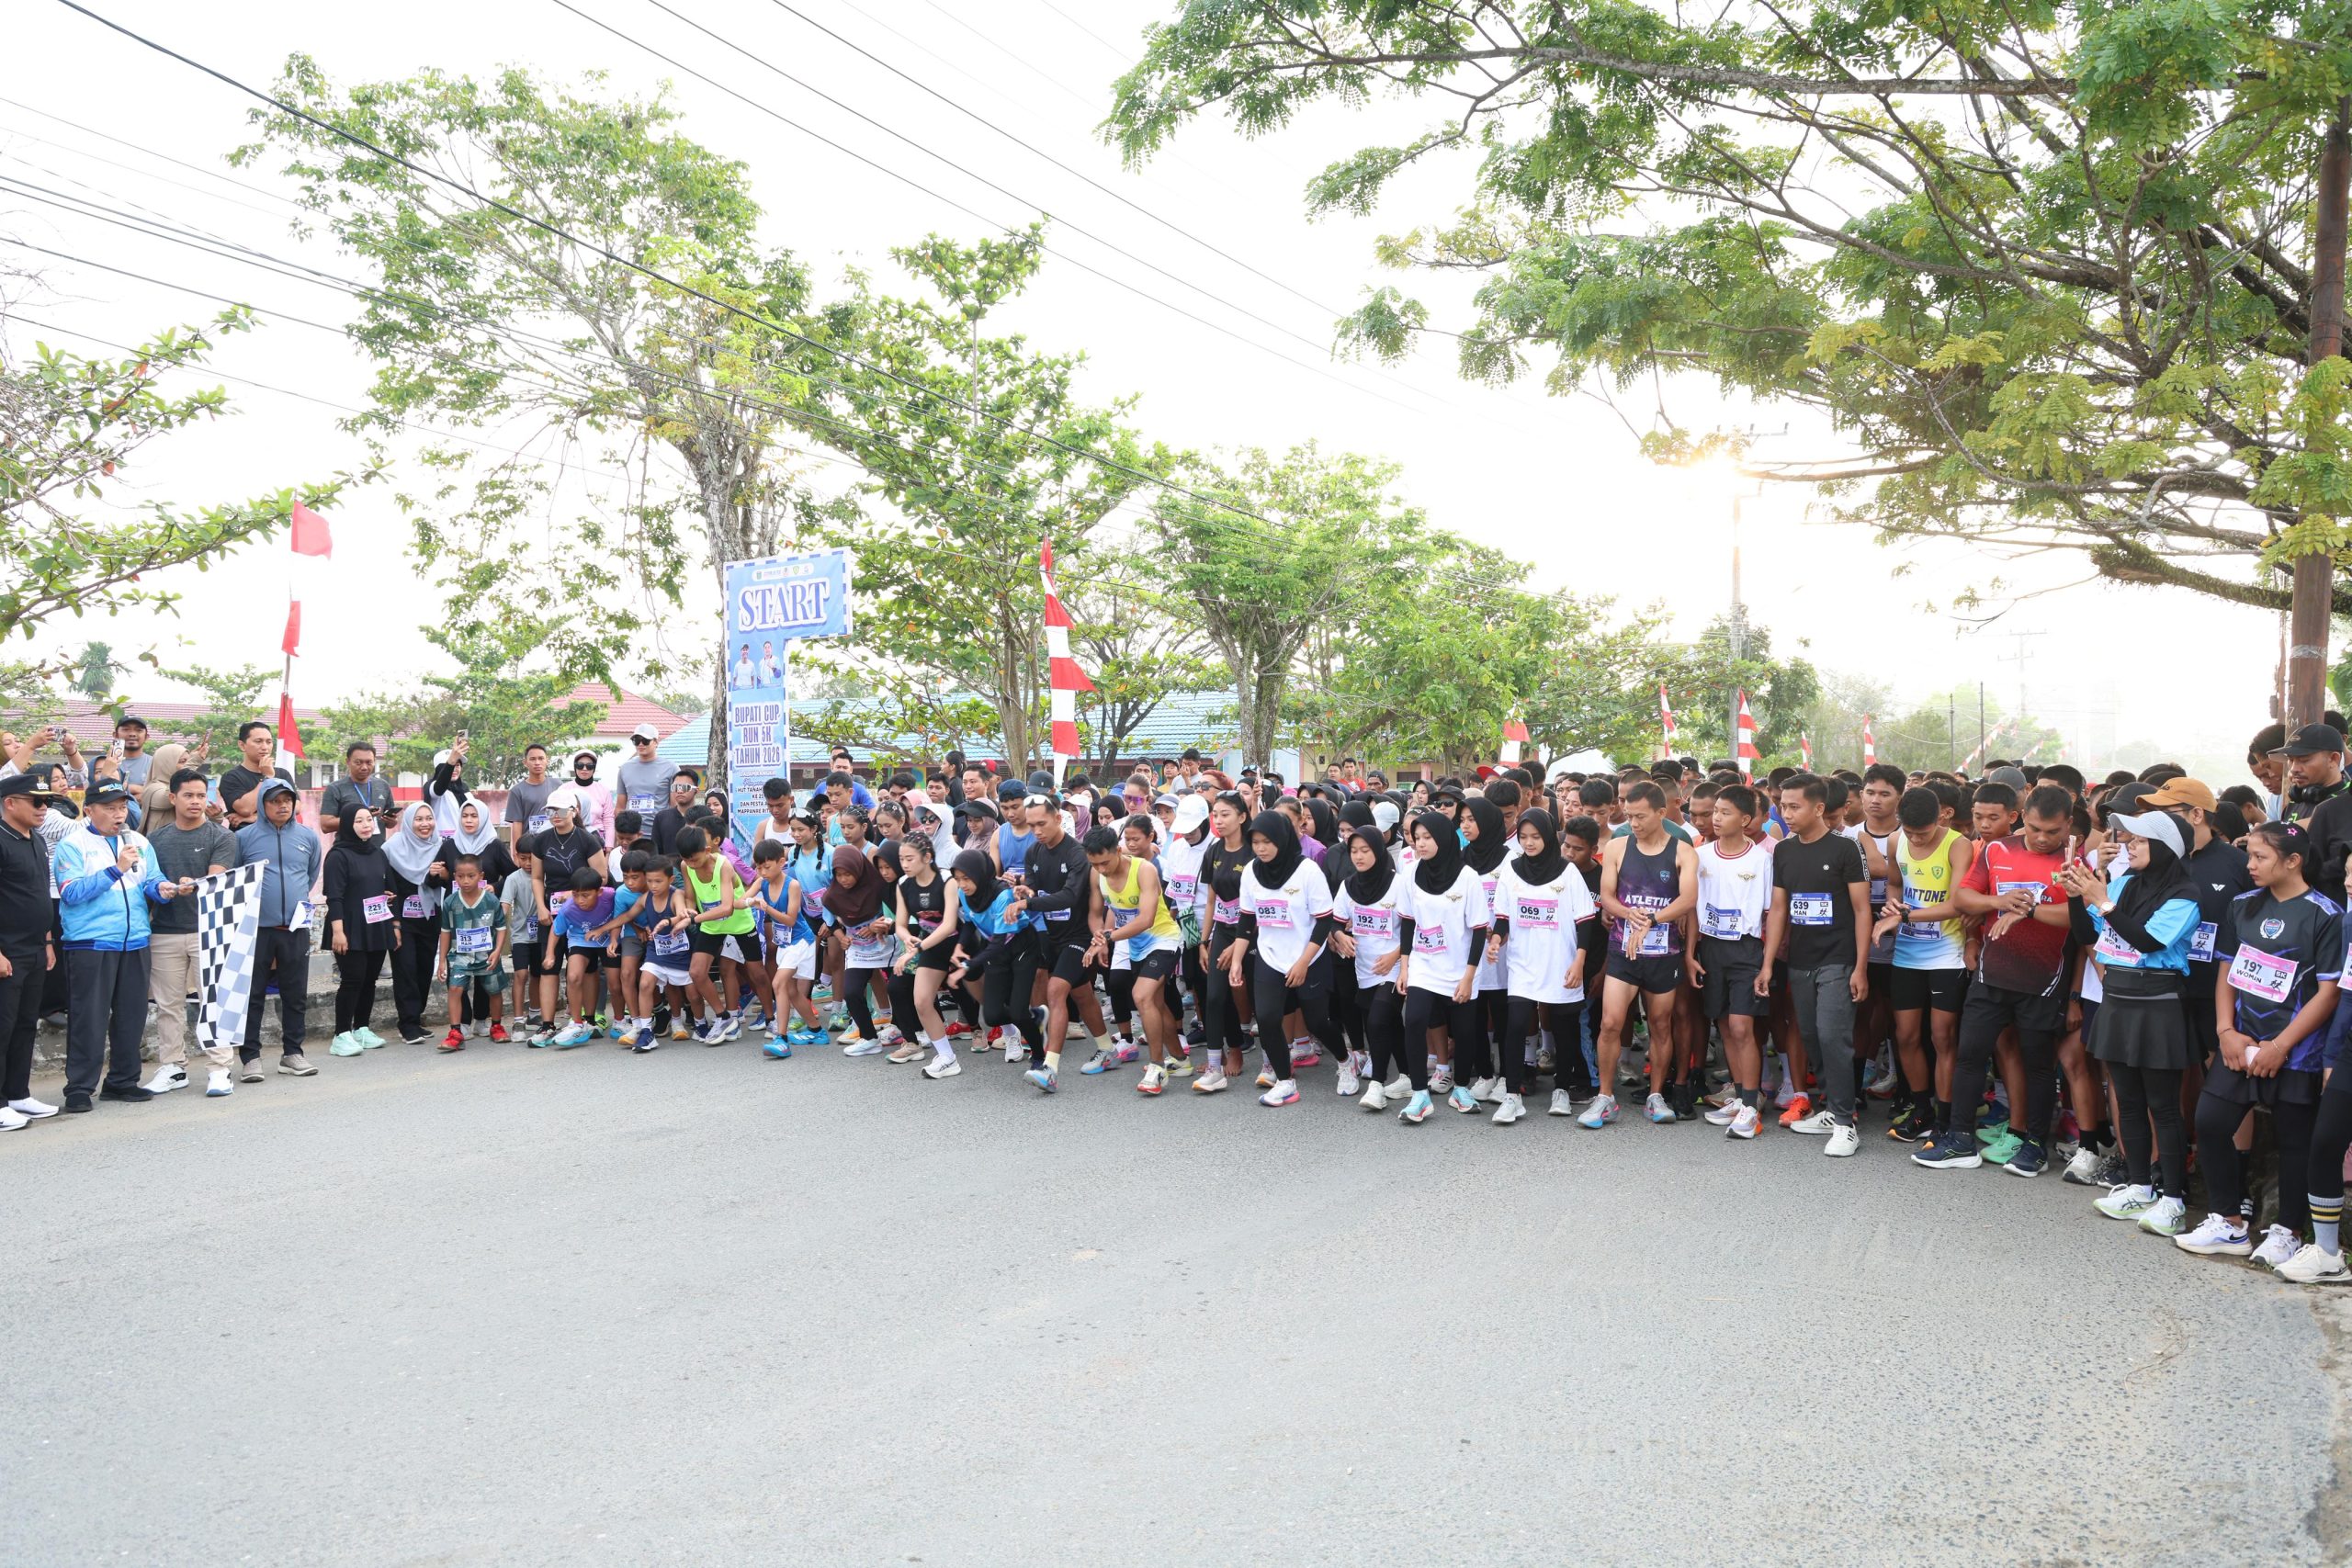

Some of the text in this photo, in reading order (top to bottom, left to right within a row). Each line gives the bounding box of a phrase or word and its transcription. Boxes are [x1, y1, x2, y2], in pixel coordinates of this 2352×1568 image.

[741, 581, 827, 627] START
[735, 704, 780, 724] BUPATI CUP
[743, 727, 759, 743] RUN
[735, 746, 780, 764] TAHUN 2026
[1624, 895, 1672, 907] ATLETIK
[1792, 901, 1809, 910] 639
[1258, 907, 1276, 915] 083
[1521, 906, 1540, 916] 069
[1357, 915, 1374, 924] 192
[2243, 959, 2288, 980] 197 5K
